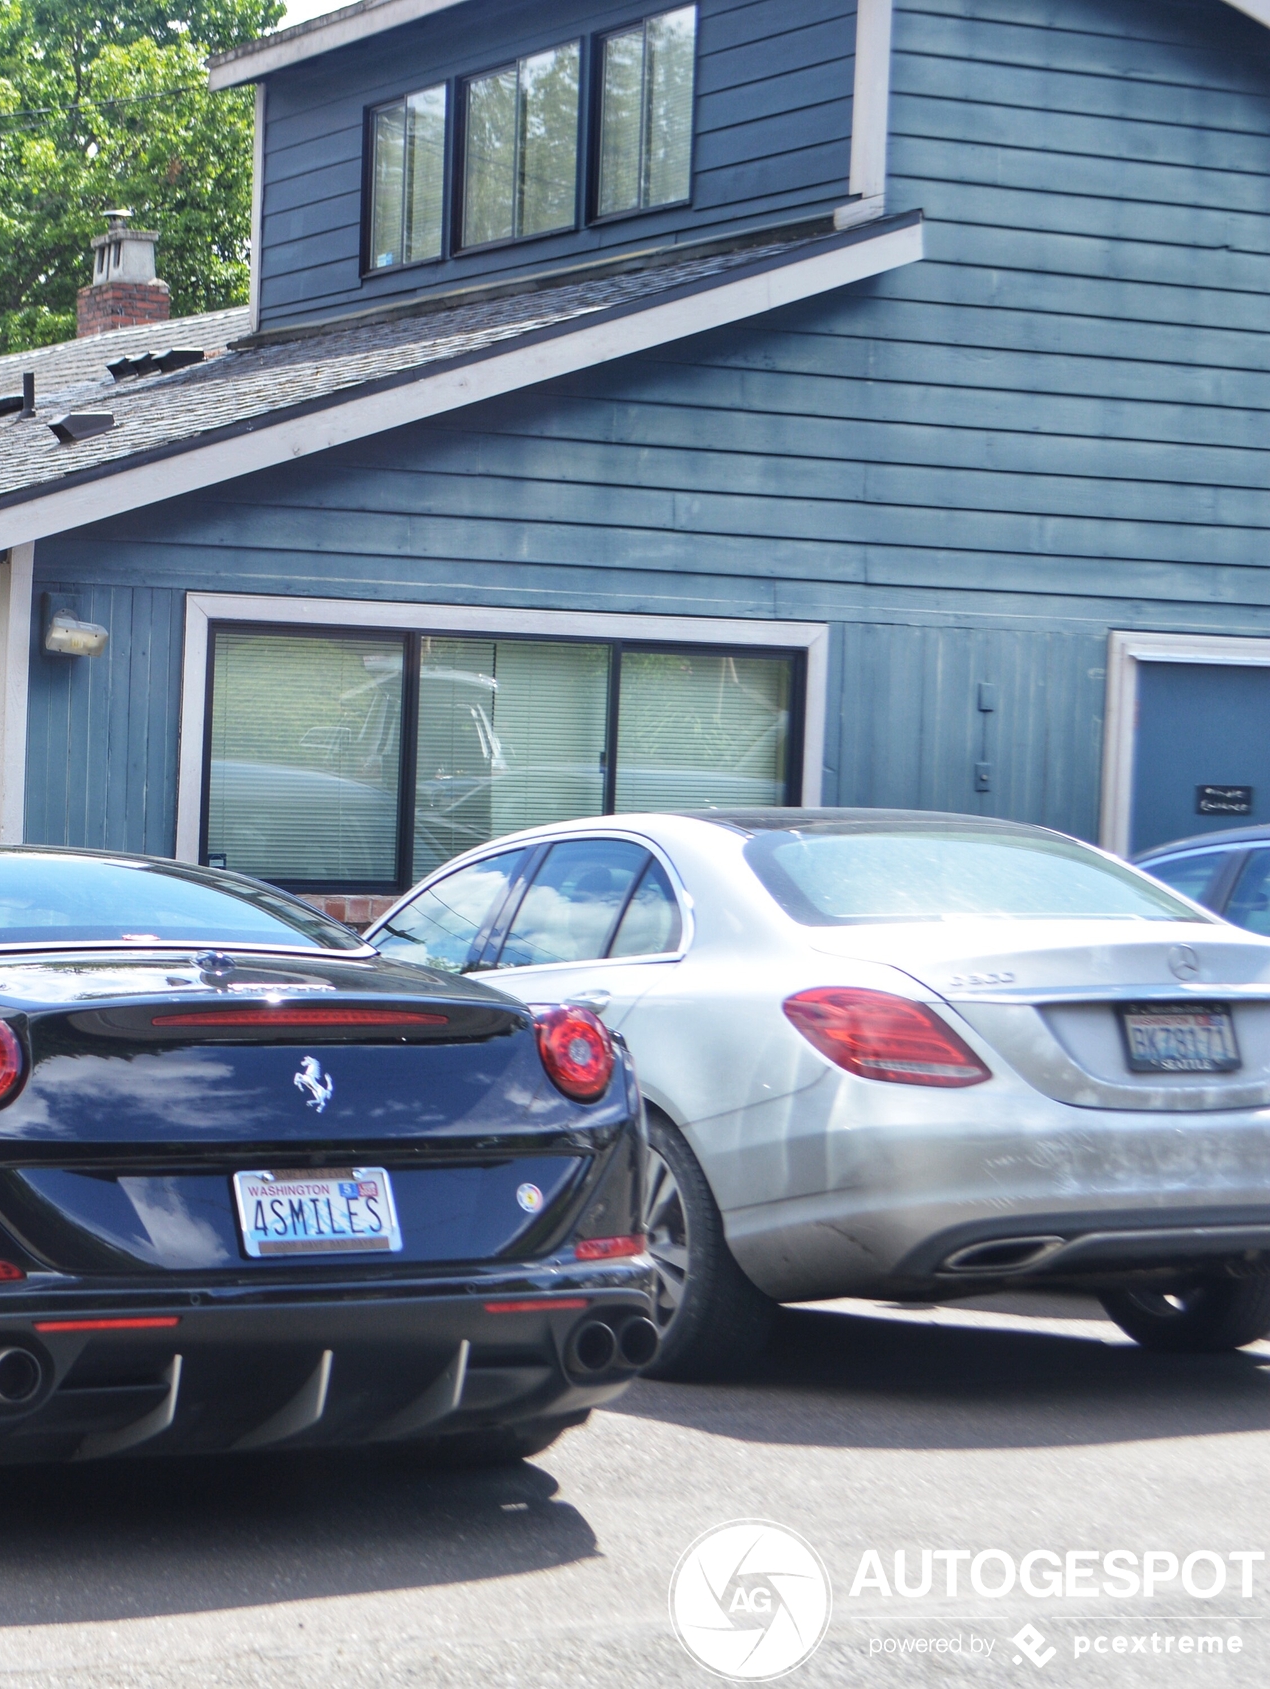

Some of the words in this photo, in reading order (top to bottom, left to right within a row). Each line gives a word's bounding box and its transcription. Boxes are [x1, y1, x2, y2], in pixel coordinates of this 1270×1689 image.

[1161, 1059, 1214, 1071] SEATTLE
[247, 1184, 330, 1197] WASHINGTON
[343, 1184, 351, 1194] 5
[253, 1196, 383, 1237] 4SMILES
